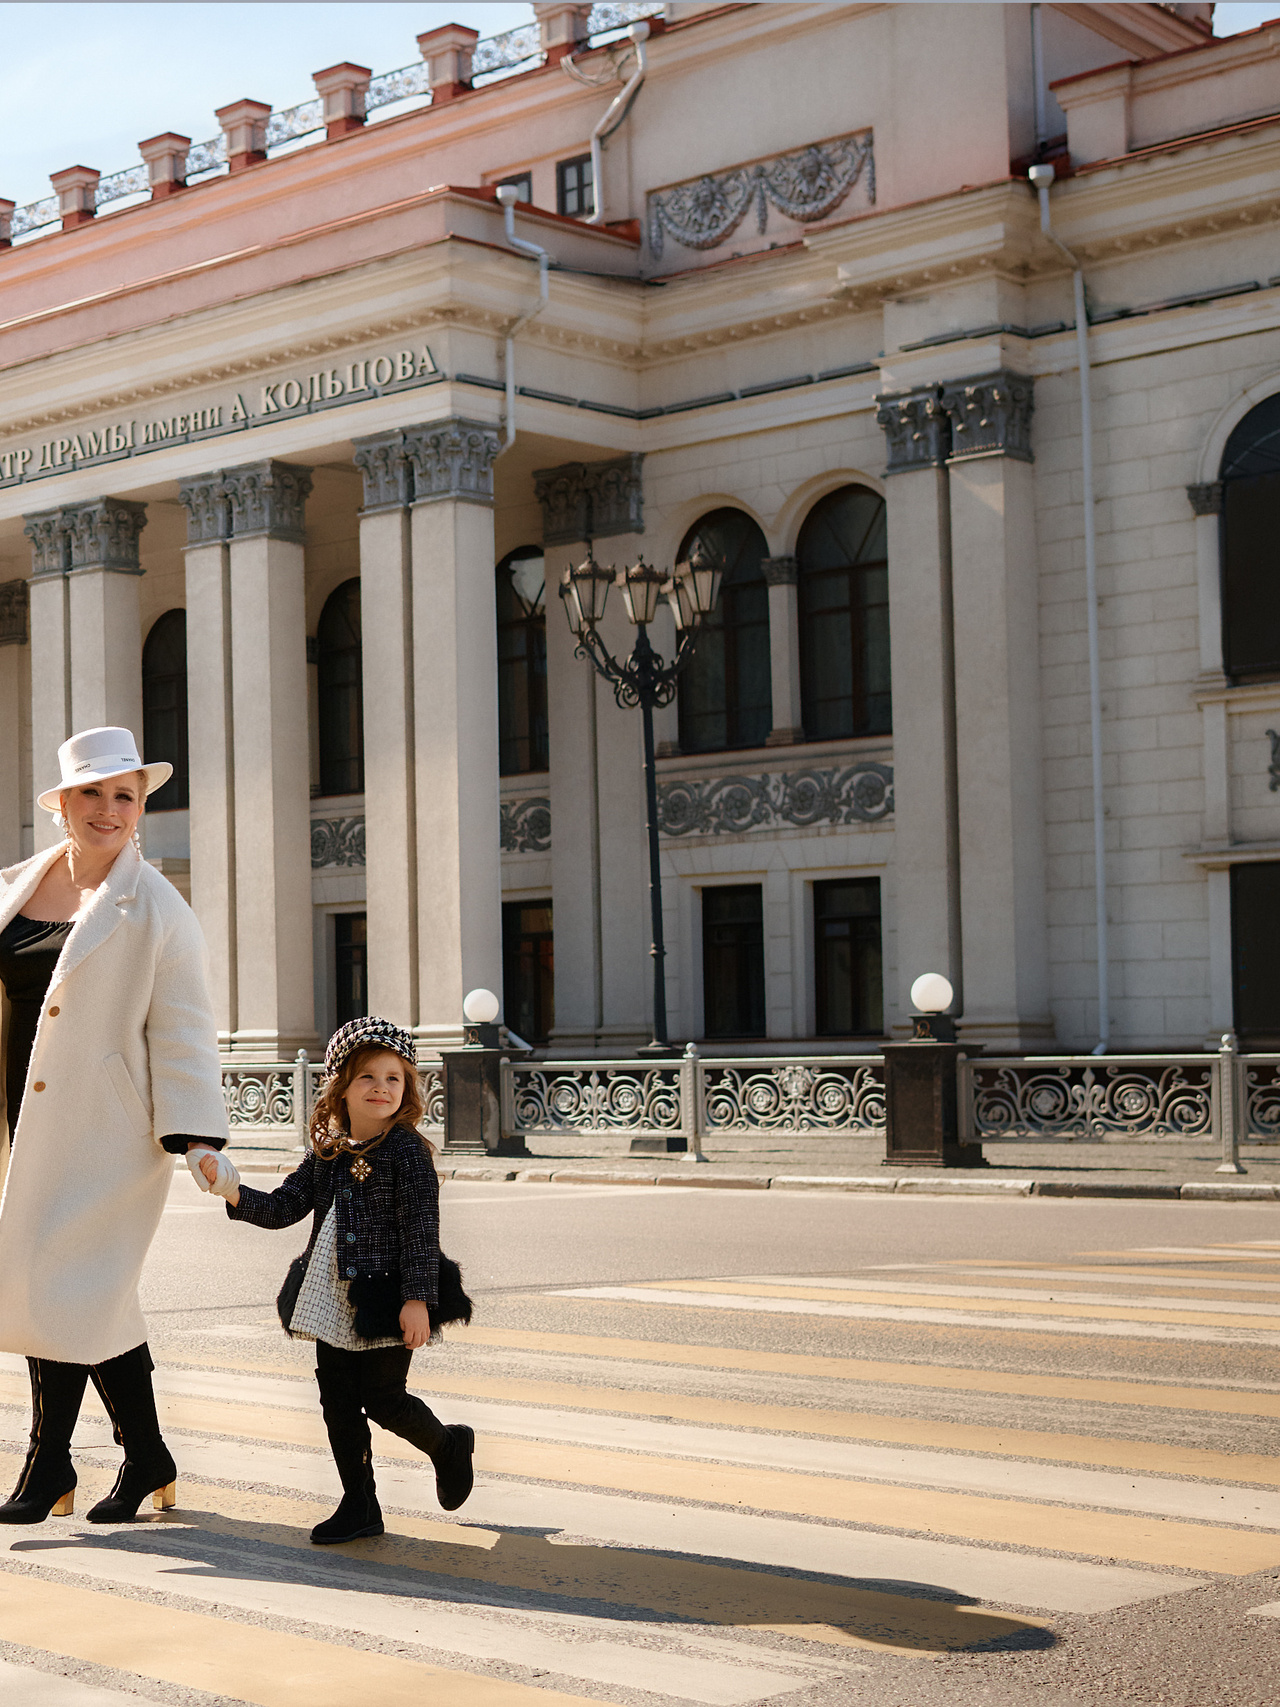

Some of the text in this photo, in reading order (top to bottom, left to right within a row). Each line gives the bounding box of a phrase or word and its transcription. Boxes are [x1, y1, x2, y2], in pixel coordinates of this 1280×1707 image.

[39, 420, 136, 471] ДРАМЫ
[230, 393, 254, 422] А.
[261, 345, 437, 416] КОЛЬЦОВА
